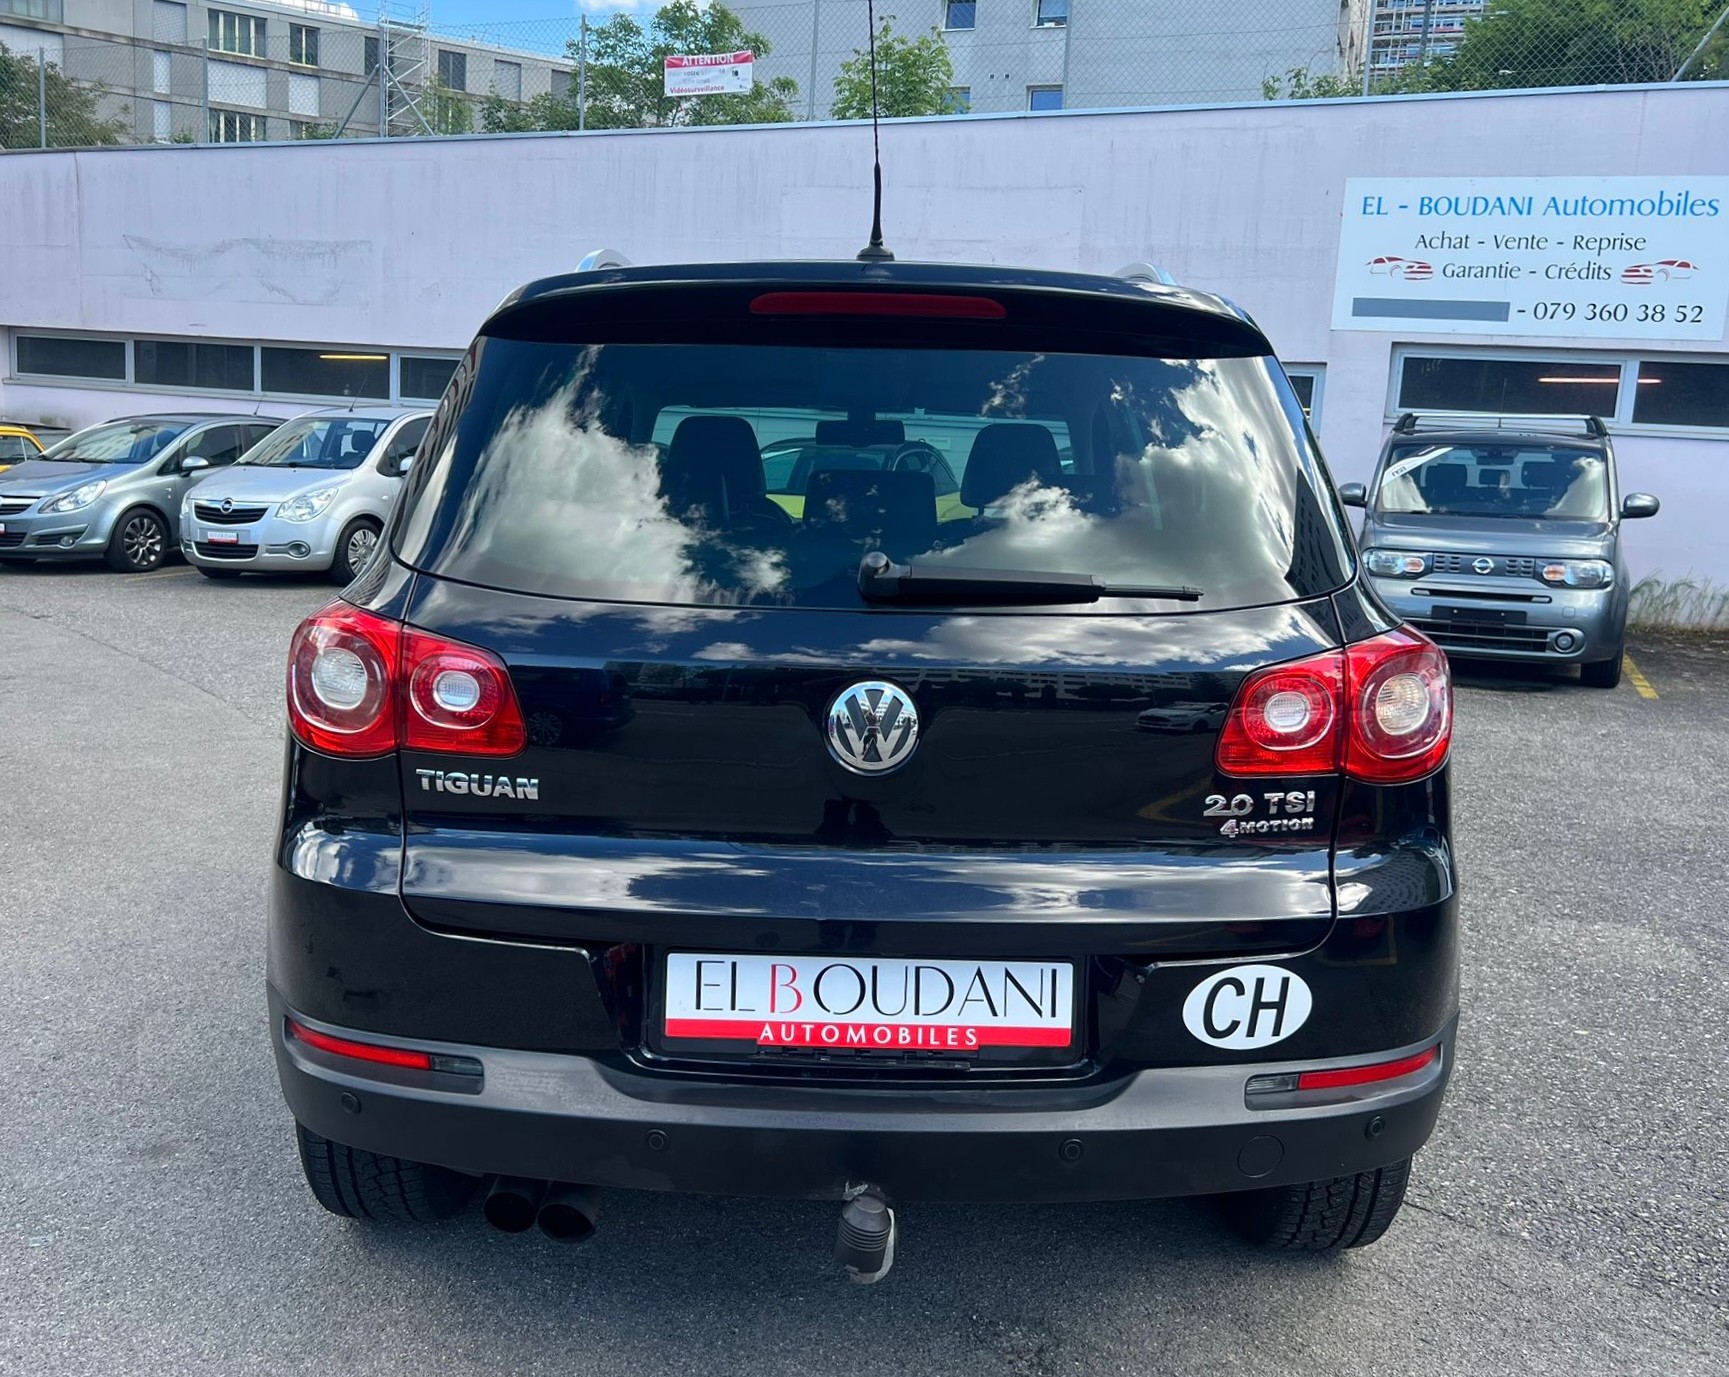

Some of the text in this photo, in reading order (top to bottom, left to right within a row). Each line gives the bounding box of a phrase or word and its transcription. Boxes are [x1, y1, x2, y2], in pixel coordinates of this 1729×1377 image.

[682, 54, 734, 66] ATTENTION
[1362, 196, 1389, 215] EL
[1418, 196, 1534, 216] BOUDANI
[1542, 190, 1720, 217] Automobiles
[1415, 230, 1470, 250] Achat
[1493, 234, 1548, 250] Vente
[1573, 233, 1647, 256] Reprise
[1442, 261, 1521, 280] Garantie
[1545, 260, 1612, 280] Crédits
[1533, 301, 1576, 320] 079
[1584, 303, 1628, 322] 360
[1635, 304, 1666, 323] 38
[1674, 305, 1704, 323] 52
[415, 768, 539, 800] TIGUAN
[1263, 790, 1316, 815] TSI
[1220, 817, 1315, 838] 4MOTION
[769, 963, 1058, 1018] BOUDANI
[1202, 976, 1291, 1040] CH
[759, 1022, 978, 1046] AUTOMOBILES
